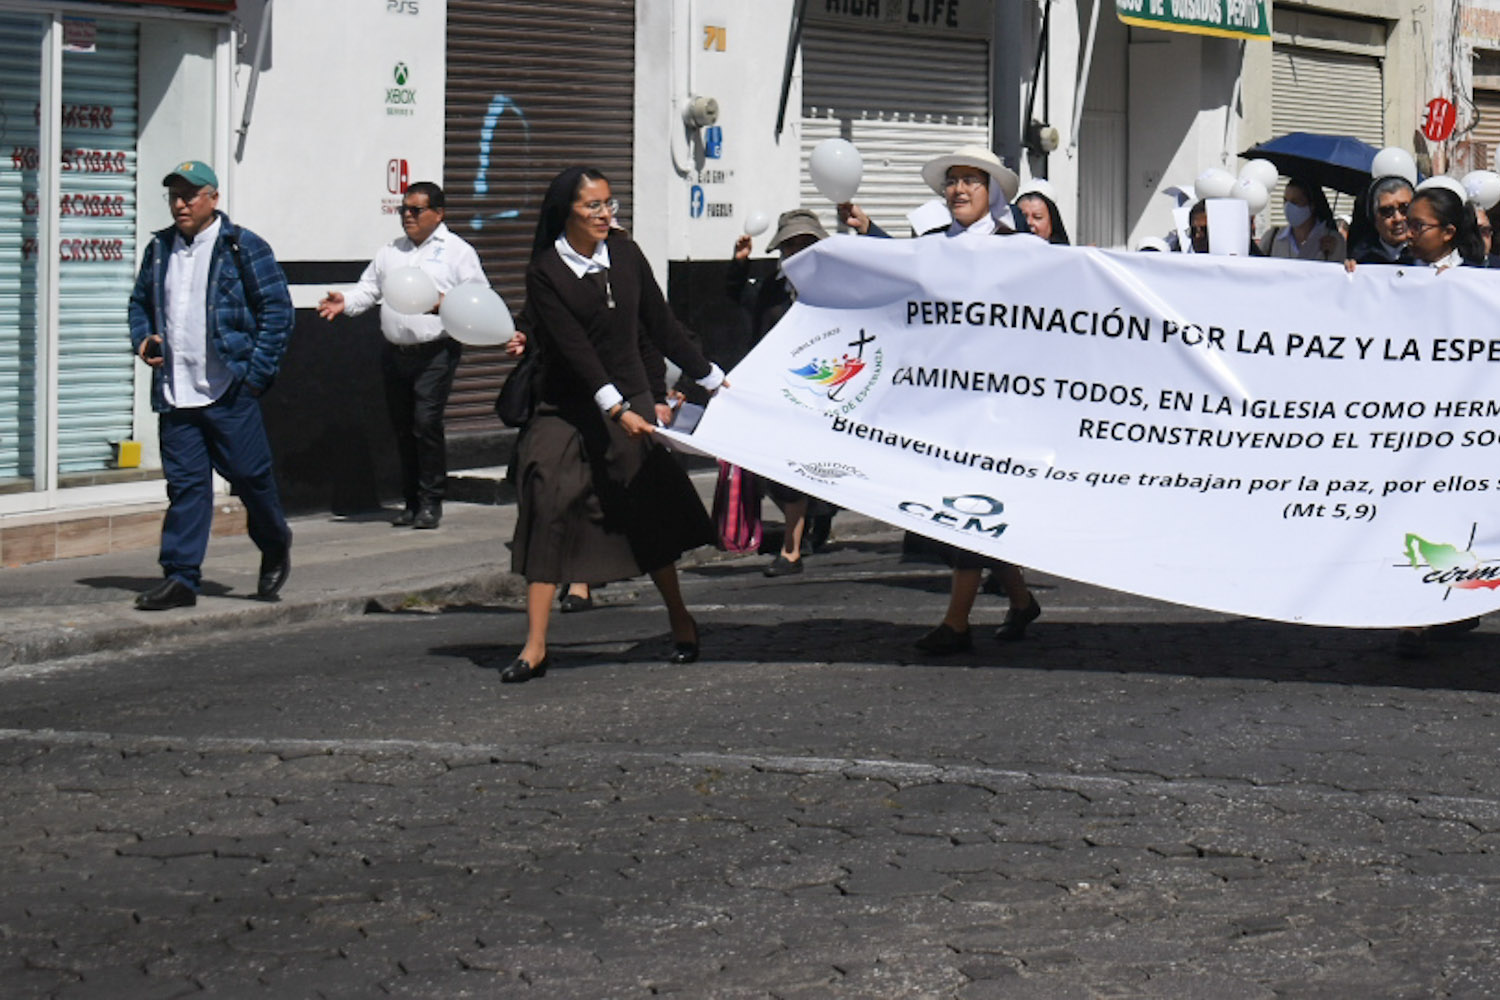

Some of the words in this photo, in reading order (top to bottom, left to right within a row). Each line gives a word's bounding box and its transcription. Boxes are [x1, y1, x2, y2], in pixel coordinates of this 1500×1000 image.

[387, 0, 419, 15] PS5
[385, 88, 417, 105] XBOX
[12, 146, 127, 173] HOSTIDAD
[23, 193, 124, 217] CACIDAD
[22, 239, 123, 261] PCRITUD
[907, 301, 1150, 341] PEREGRINACIÓN
[1162, 320, 1225, 350] POR
[1237, 330, 1274, 355] LA
[1286, 334, 1346, 359] PAZ
[1355, 337, 1375, 360] Y
[1383, 338, 1420, 361] LA
[892, 366, 1046, 397] CAMINEMOS
[1054, 379, 1149, 411] TODOS,
[1159, 390, 1193, 411] EN
[1201, 394, 1233, 416] LA
[1242, 398, 1336, 418] IGLESIA
[1345, 401, 1425, 419] COMO
[1079, 418, 1324, 449] RECONSTRUYENDO
[1331, 432, 1359, 449] EL
[1370, 431, 1454, 452] TEJIDO
[1045, 466, 1079, 481] los
[1085, 472, 1131, 487] que
[1137, 472, 1242, 493] trabajan
[1248, 478, 1291, 494] por
[1298, 476, 1319, 491] la
[1326, 479, 1374, 496] paz,
[1382, 479, 1426, 496] por
[1433, 476, 1489, 493] ellos
[898, 501, 1009, 538] CEM
[1283, 503, 1326, 519] (Mt
[1332, 503, 1377, 522] 5,9)
